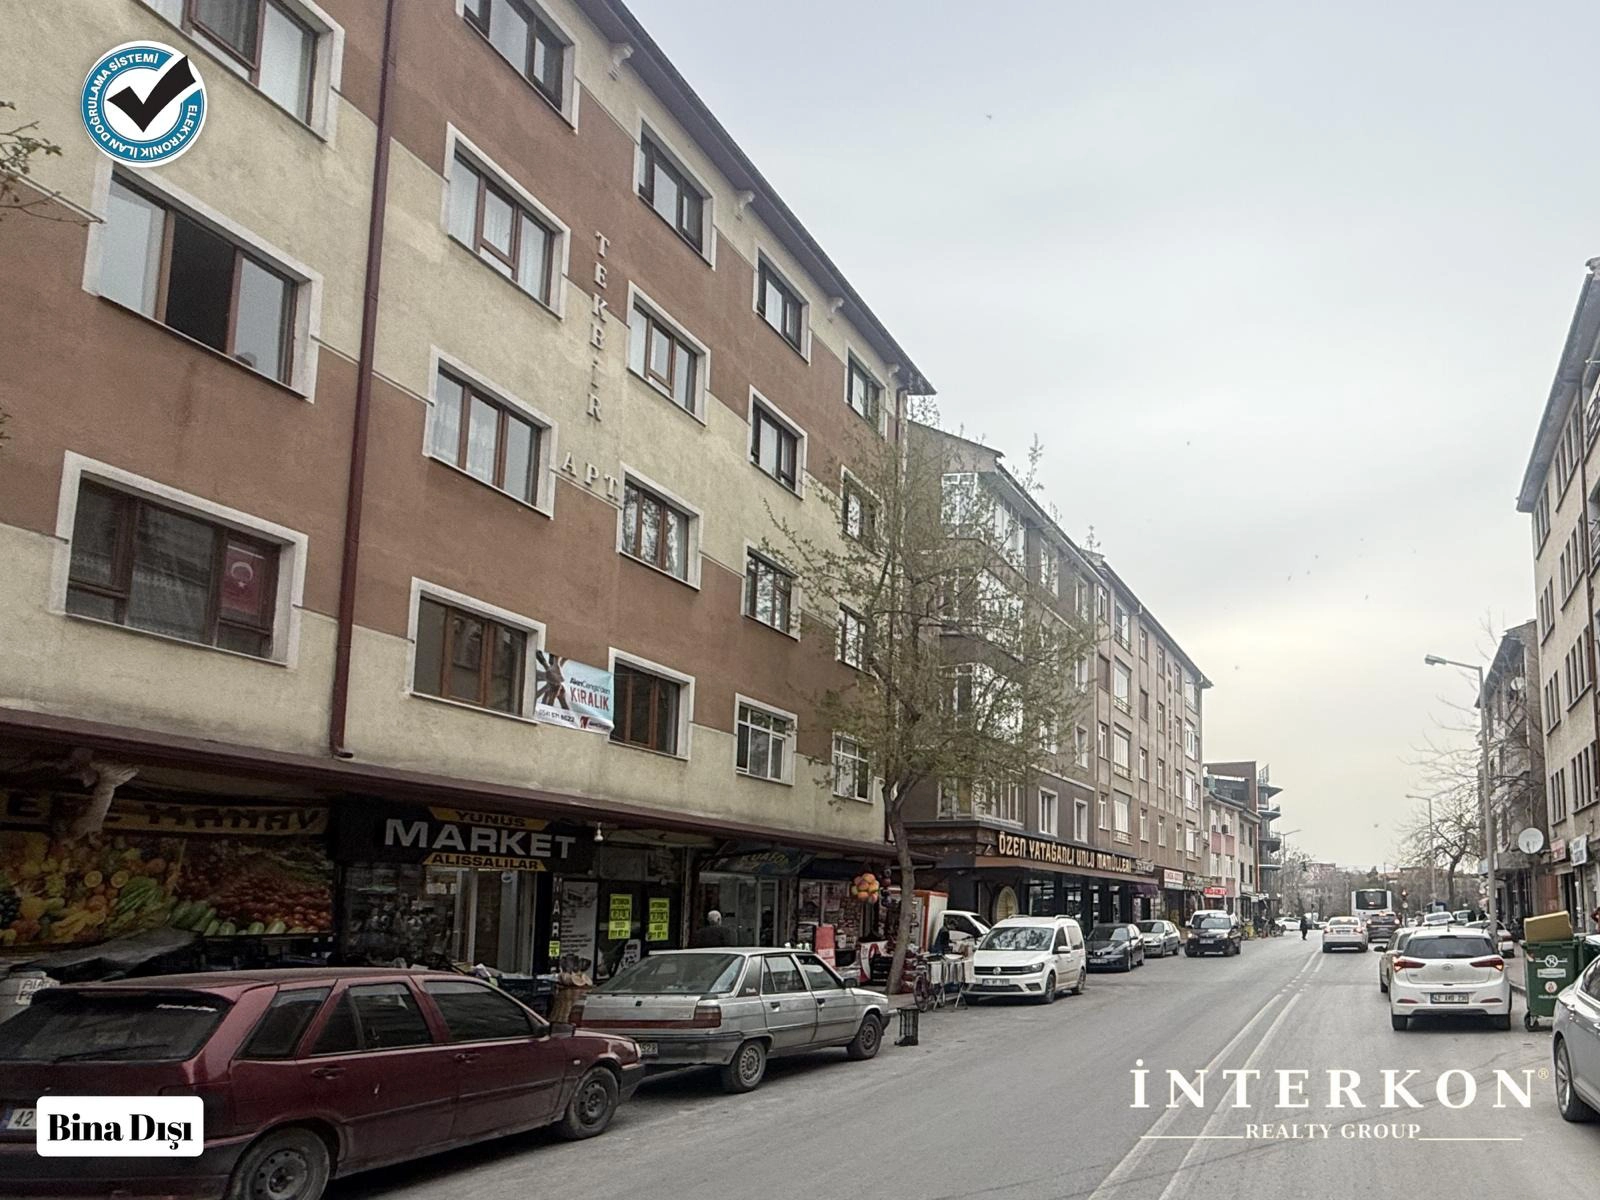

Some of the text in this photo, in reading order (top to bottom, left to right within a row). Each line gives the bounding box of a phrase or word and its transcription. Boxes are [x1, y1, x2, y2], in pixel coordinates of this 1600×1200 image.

[560, 452, 619, 501] APT
[570, 686, 610, 711] KİRALIK
[455, 810, 526, 828] YUNUS
[384, 818, 577, 859] MARKET
[998, 831, 1027, 858] ÖZEN
[1076, 849, 1095, 868] UNLU
[14, 1110, 34, 1127] 42
